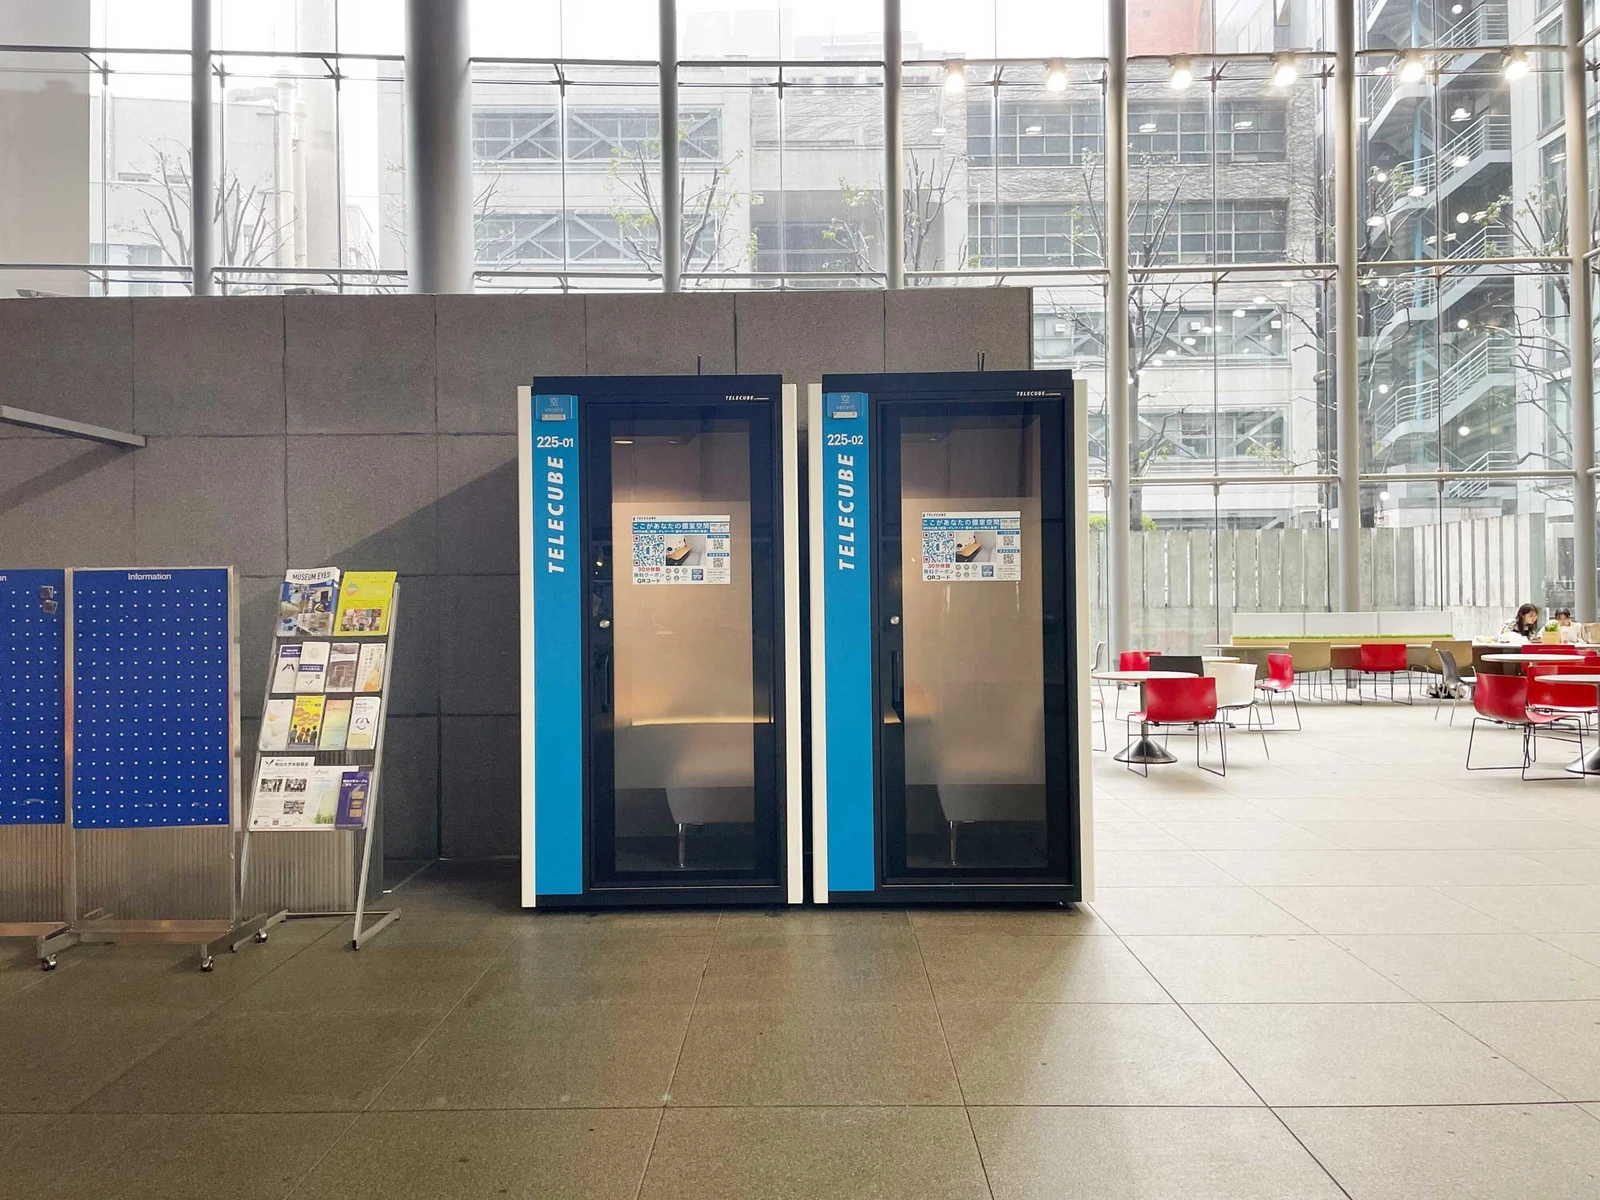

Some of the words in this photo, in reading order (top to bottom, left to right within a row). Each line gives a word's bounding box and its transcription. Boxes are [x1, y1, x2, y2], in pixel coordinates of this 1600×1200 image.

[536, 435, 574, 448] 225-01
[827, 433, 864, 446] 225-02
[547, 455, 565, 574] TELECUBE
[837, 453, 855, 571] TELECUBE
[127, 572, 172, 581] Information
[291, 573, 317, 581] MUSEUM
